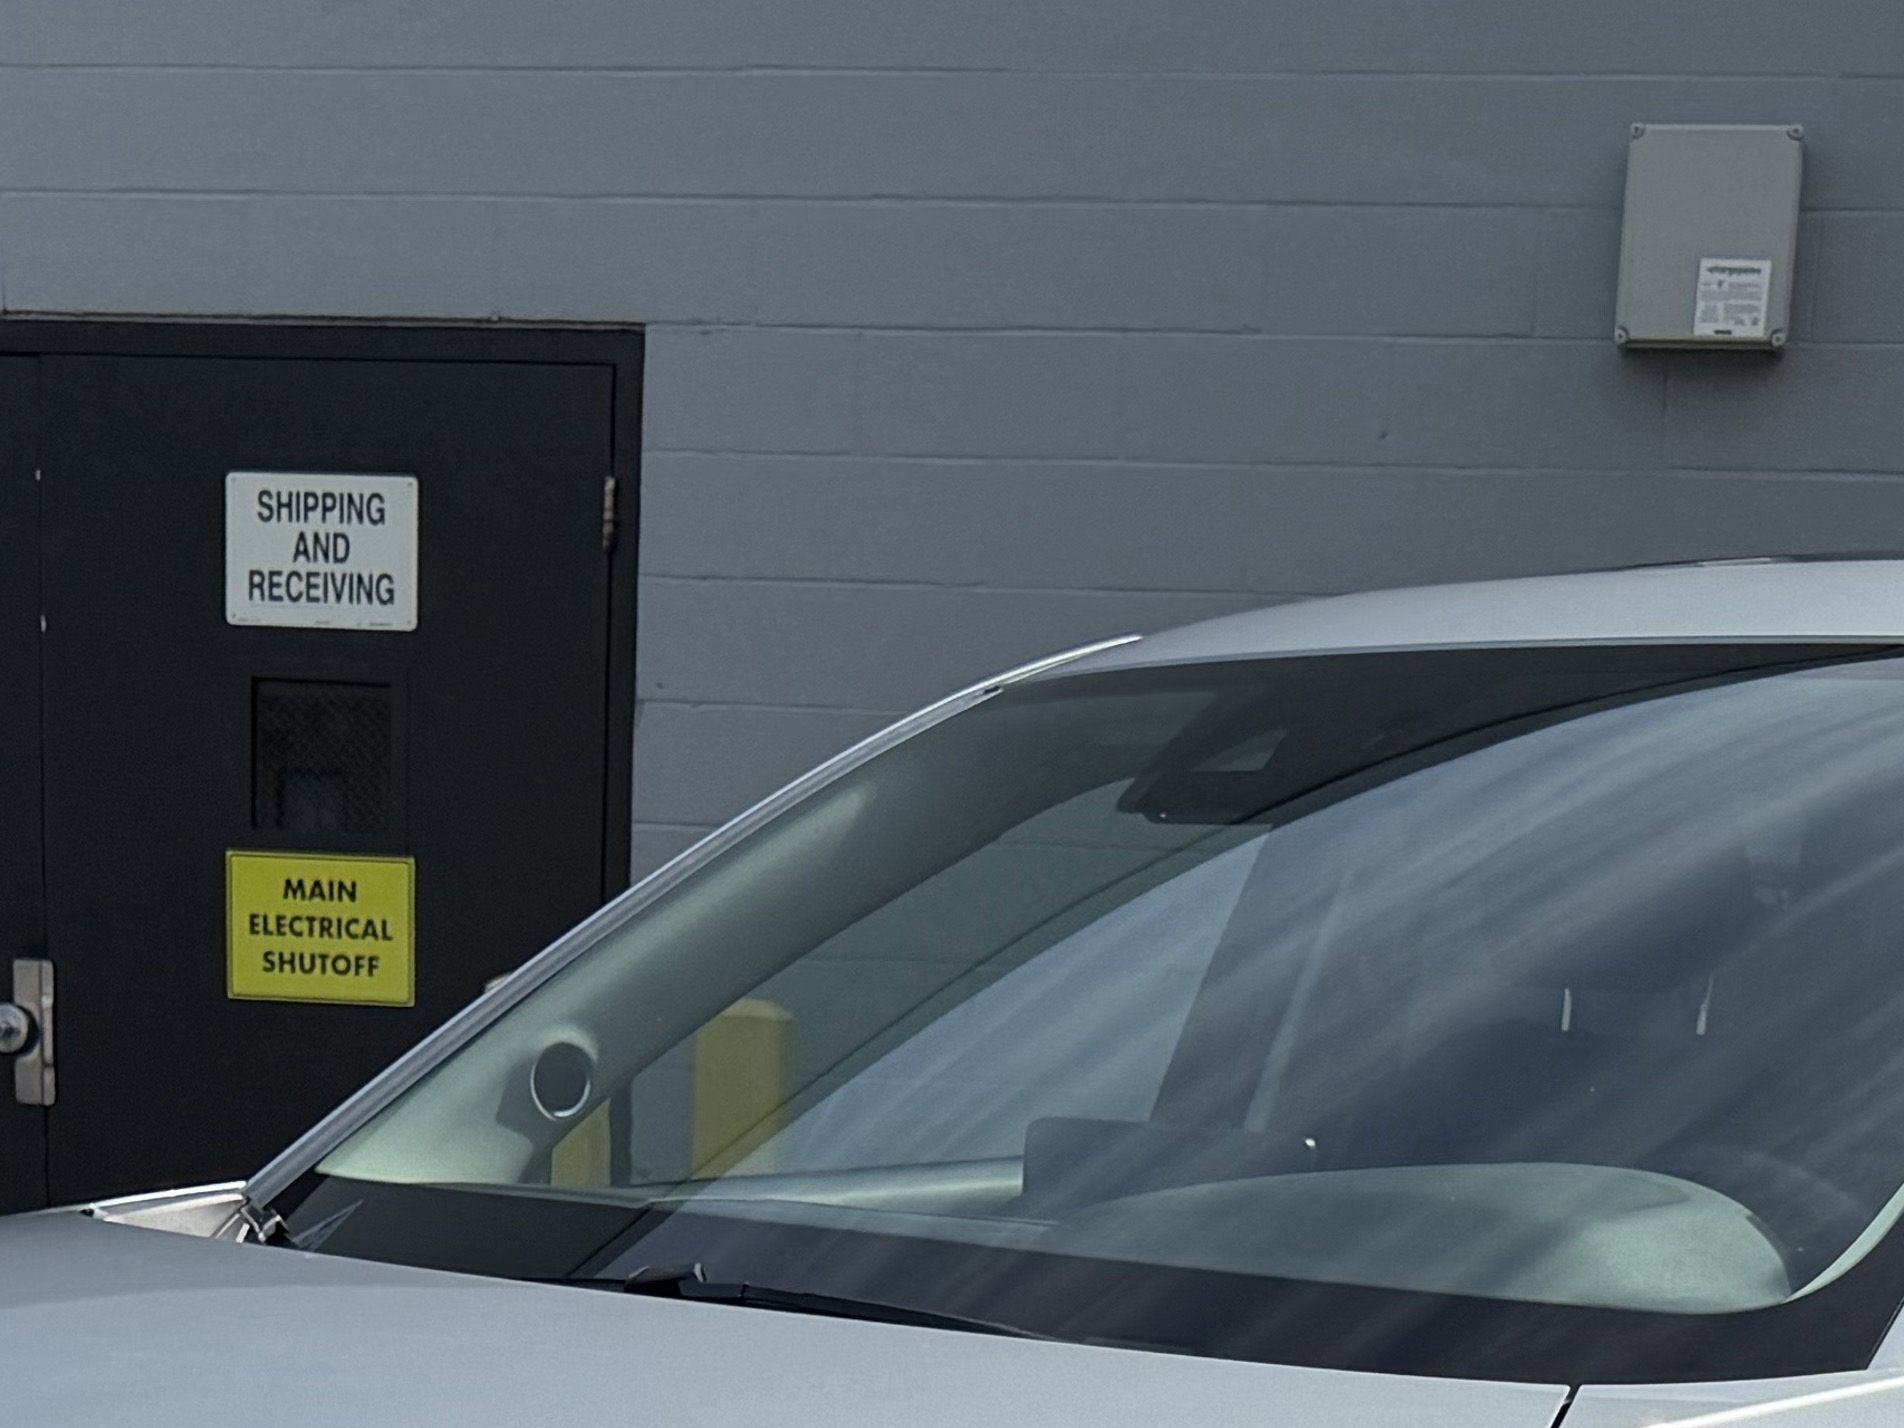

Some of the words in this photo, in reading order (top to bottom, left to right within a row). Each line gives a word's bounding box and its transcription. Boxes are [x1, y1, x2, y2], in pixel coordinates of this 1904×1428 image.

[257, 490, 385, 525] SHIPPING
[293, 531, 350, 564] AND
[249, 569, 395, 606] RECEIVING
[283, 878, 357, 903] MAIN
[249, 913, 393, 941] ELECTRICAL
[262, 951, 380, 977] SHUTOFF
